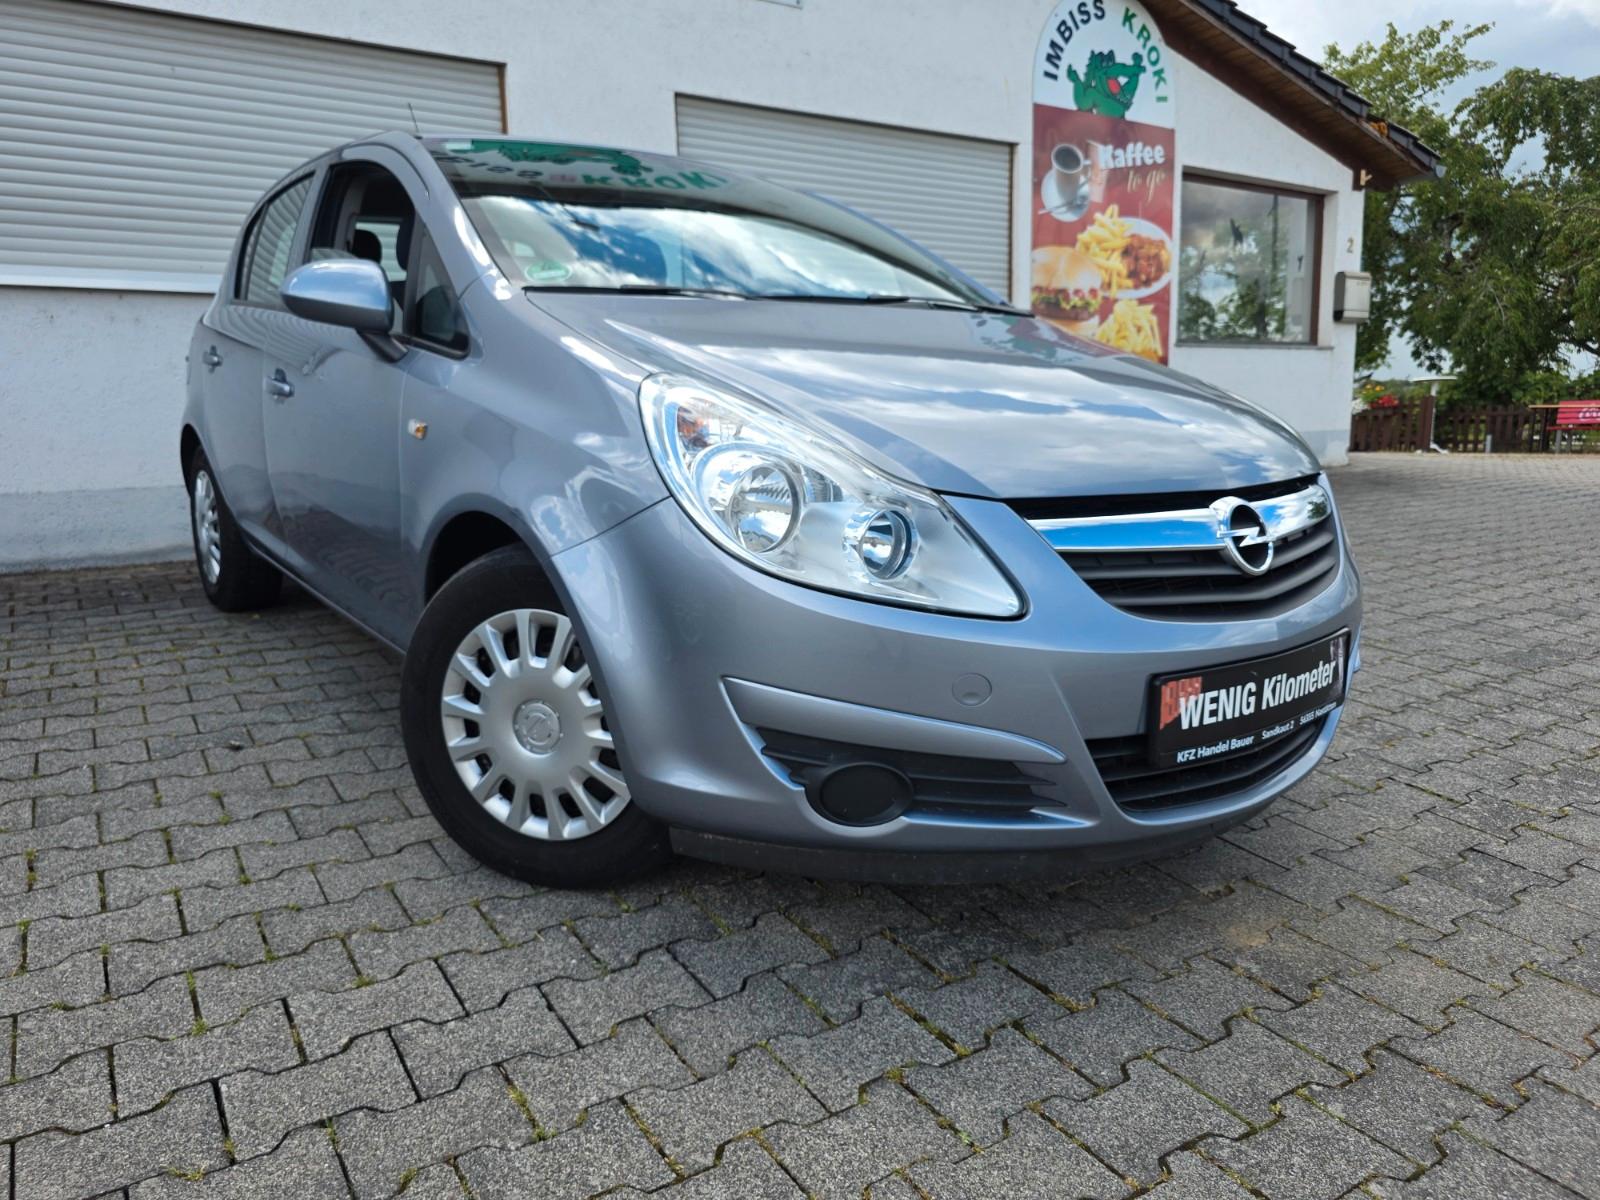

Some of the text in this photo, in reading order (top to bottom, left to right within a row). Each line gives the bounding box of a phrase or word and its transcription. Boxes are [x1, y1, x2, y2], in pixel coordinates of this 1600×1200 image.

[1043, 0, 1169, 103] IMBISS KROKI
[1098, 142, 1165, 170] Kaffee
[1126, 169, 1166, 205] to go
[1346, 236, 1354, 254] 2
[1179, 682, 1257, 730] WENIG
[1261, 660, 1337, 710] Kilometer
[1176, 748, 1197, 764] KFZ
[1197, 740, 1230, 758] Handel
[1230, 735, 1255, 750] Bauer
